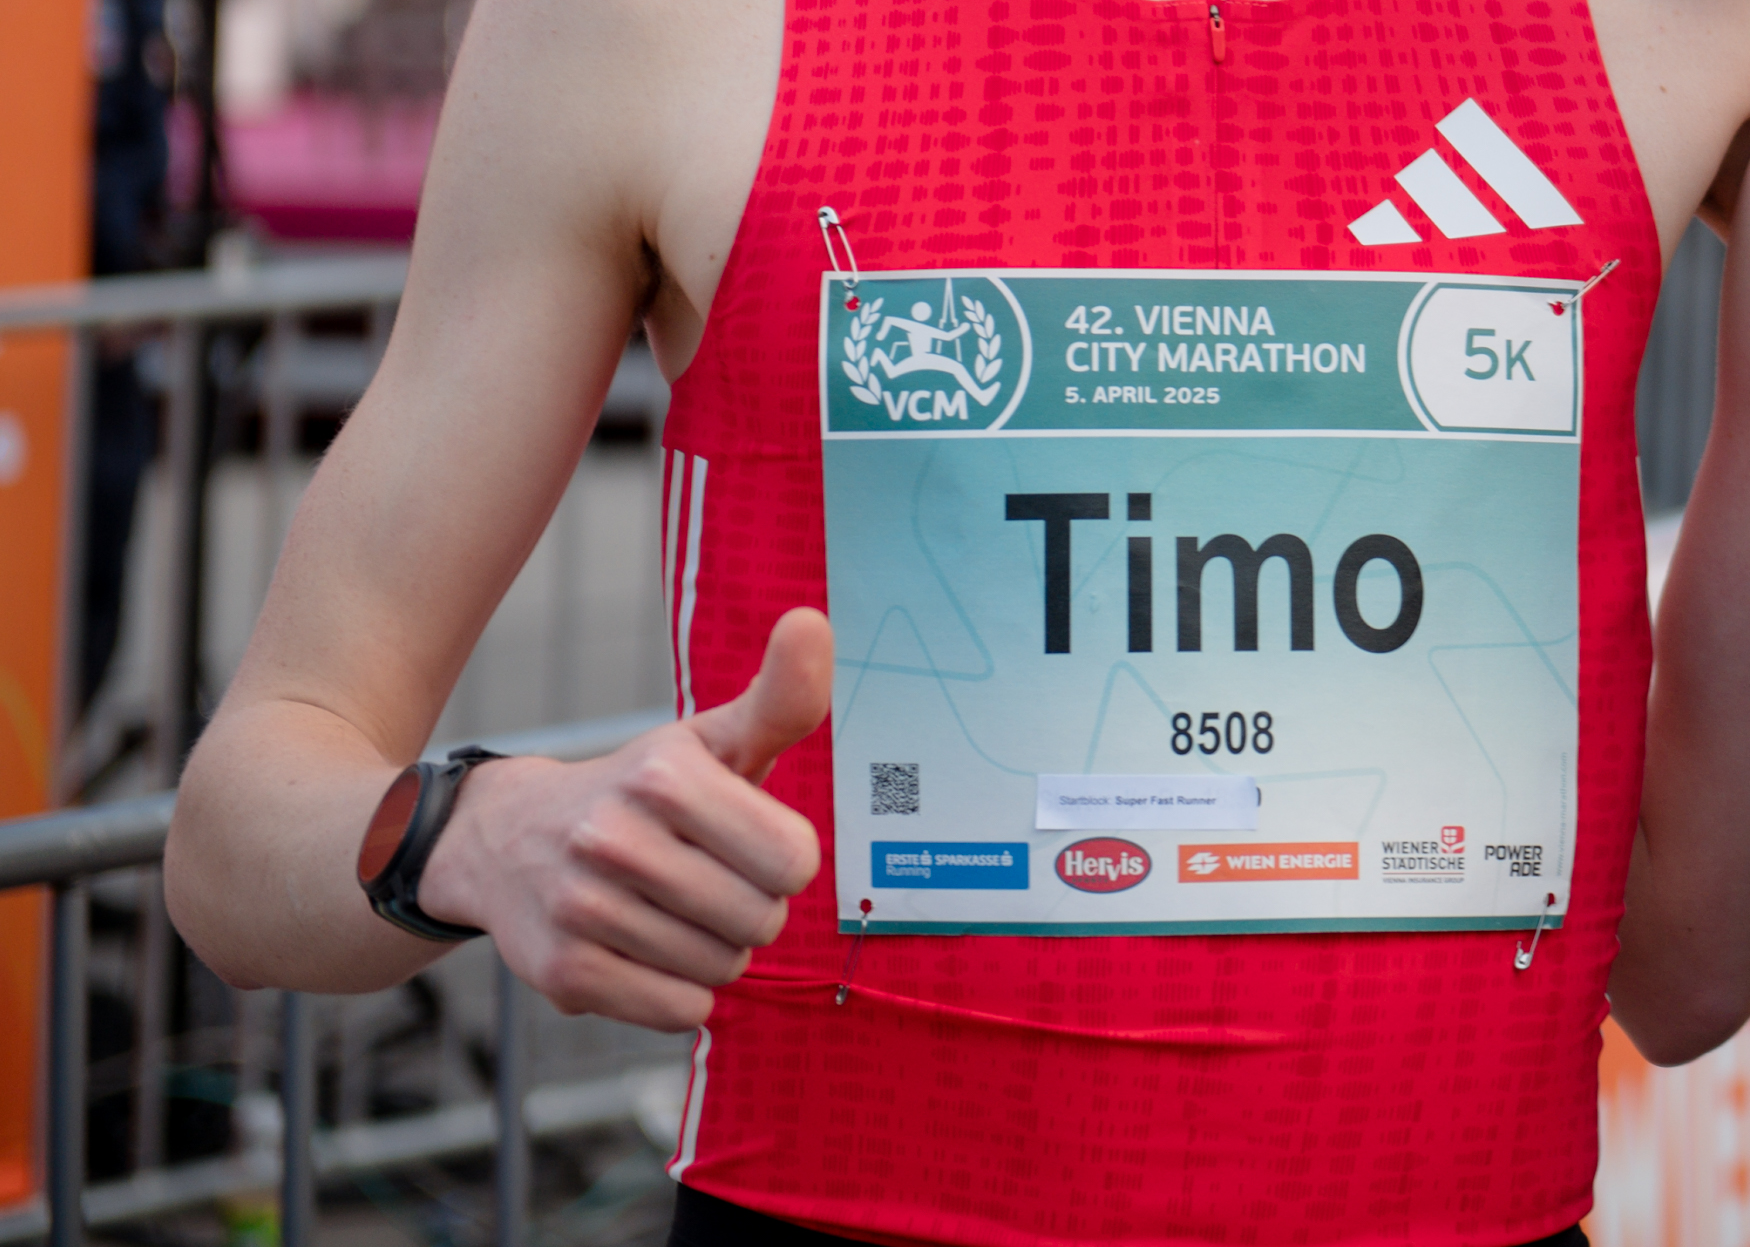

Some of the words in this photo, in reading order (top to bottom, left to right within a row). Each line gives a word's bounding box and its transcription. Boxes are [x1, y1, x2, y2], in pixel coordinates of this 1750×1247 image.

[1065, 305, 1124, 335] 42.
[1134, 305, 1276, 336] VIENNA
[1065, 342, 1147, 372] CITY
[1157, 342, 1366, 373] MARATHON
[1463, 328, 1536, 382] 5K
[1065, 386, 1086, 403] 5.
[1092, 386, 1157, 403] APRIL
[1163, 387, 1221, 404] 2025
[882, 390, 968, 421] VCM
[1005, 493, 1424, 654] Timo
[1170, 710, 1275, 755] 8508
[1177, 795, 1216, 806] Runner
[1381, 841, 1439, 854] WIENER
[1485, 845, 1543, 860] POWER
[935, 854, 1000, 867] SPARKASSE
[1065, 850, 1144, 881] Hervis
[1226, 855, 1275, 870] WIEN
[1279, 854, 1352, 869] ENERGIE
[1510, 862, 1542, 877] ADE
[886, 866, 931, 878] Running
